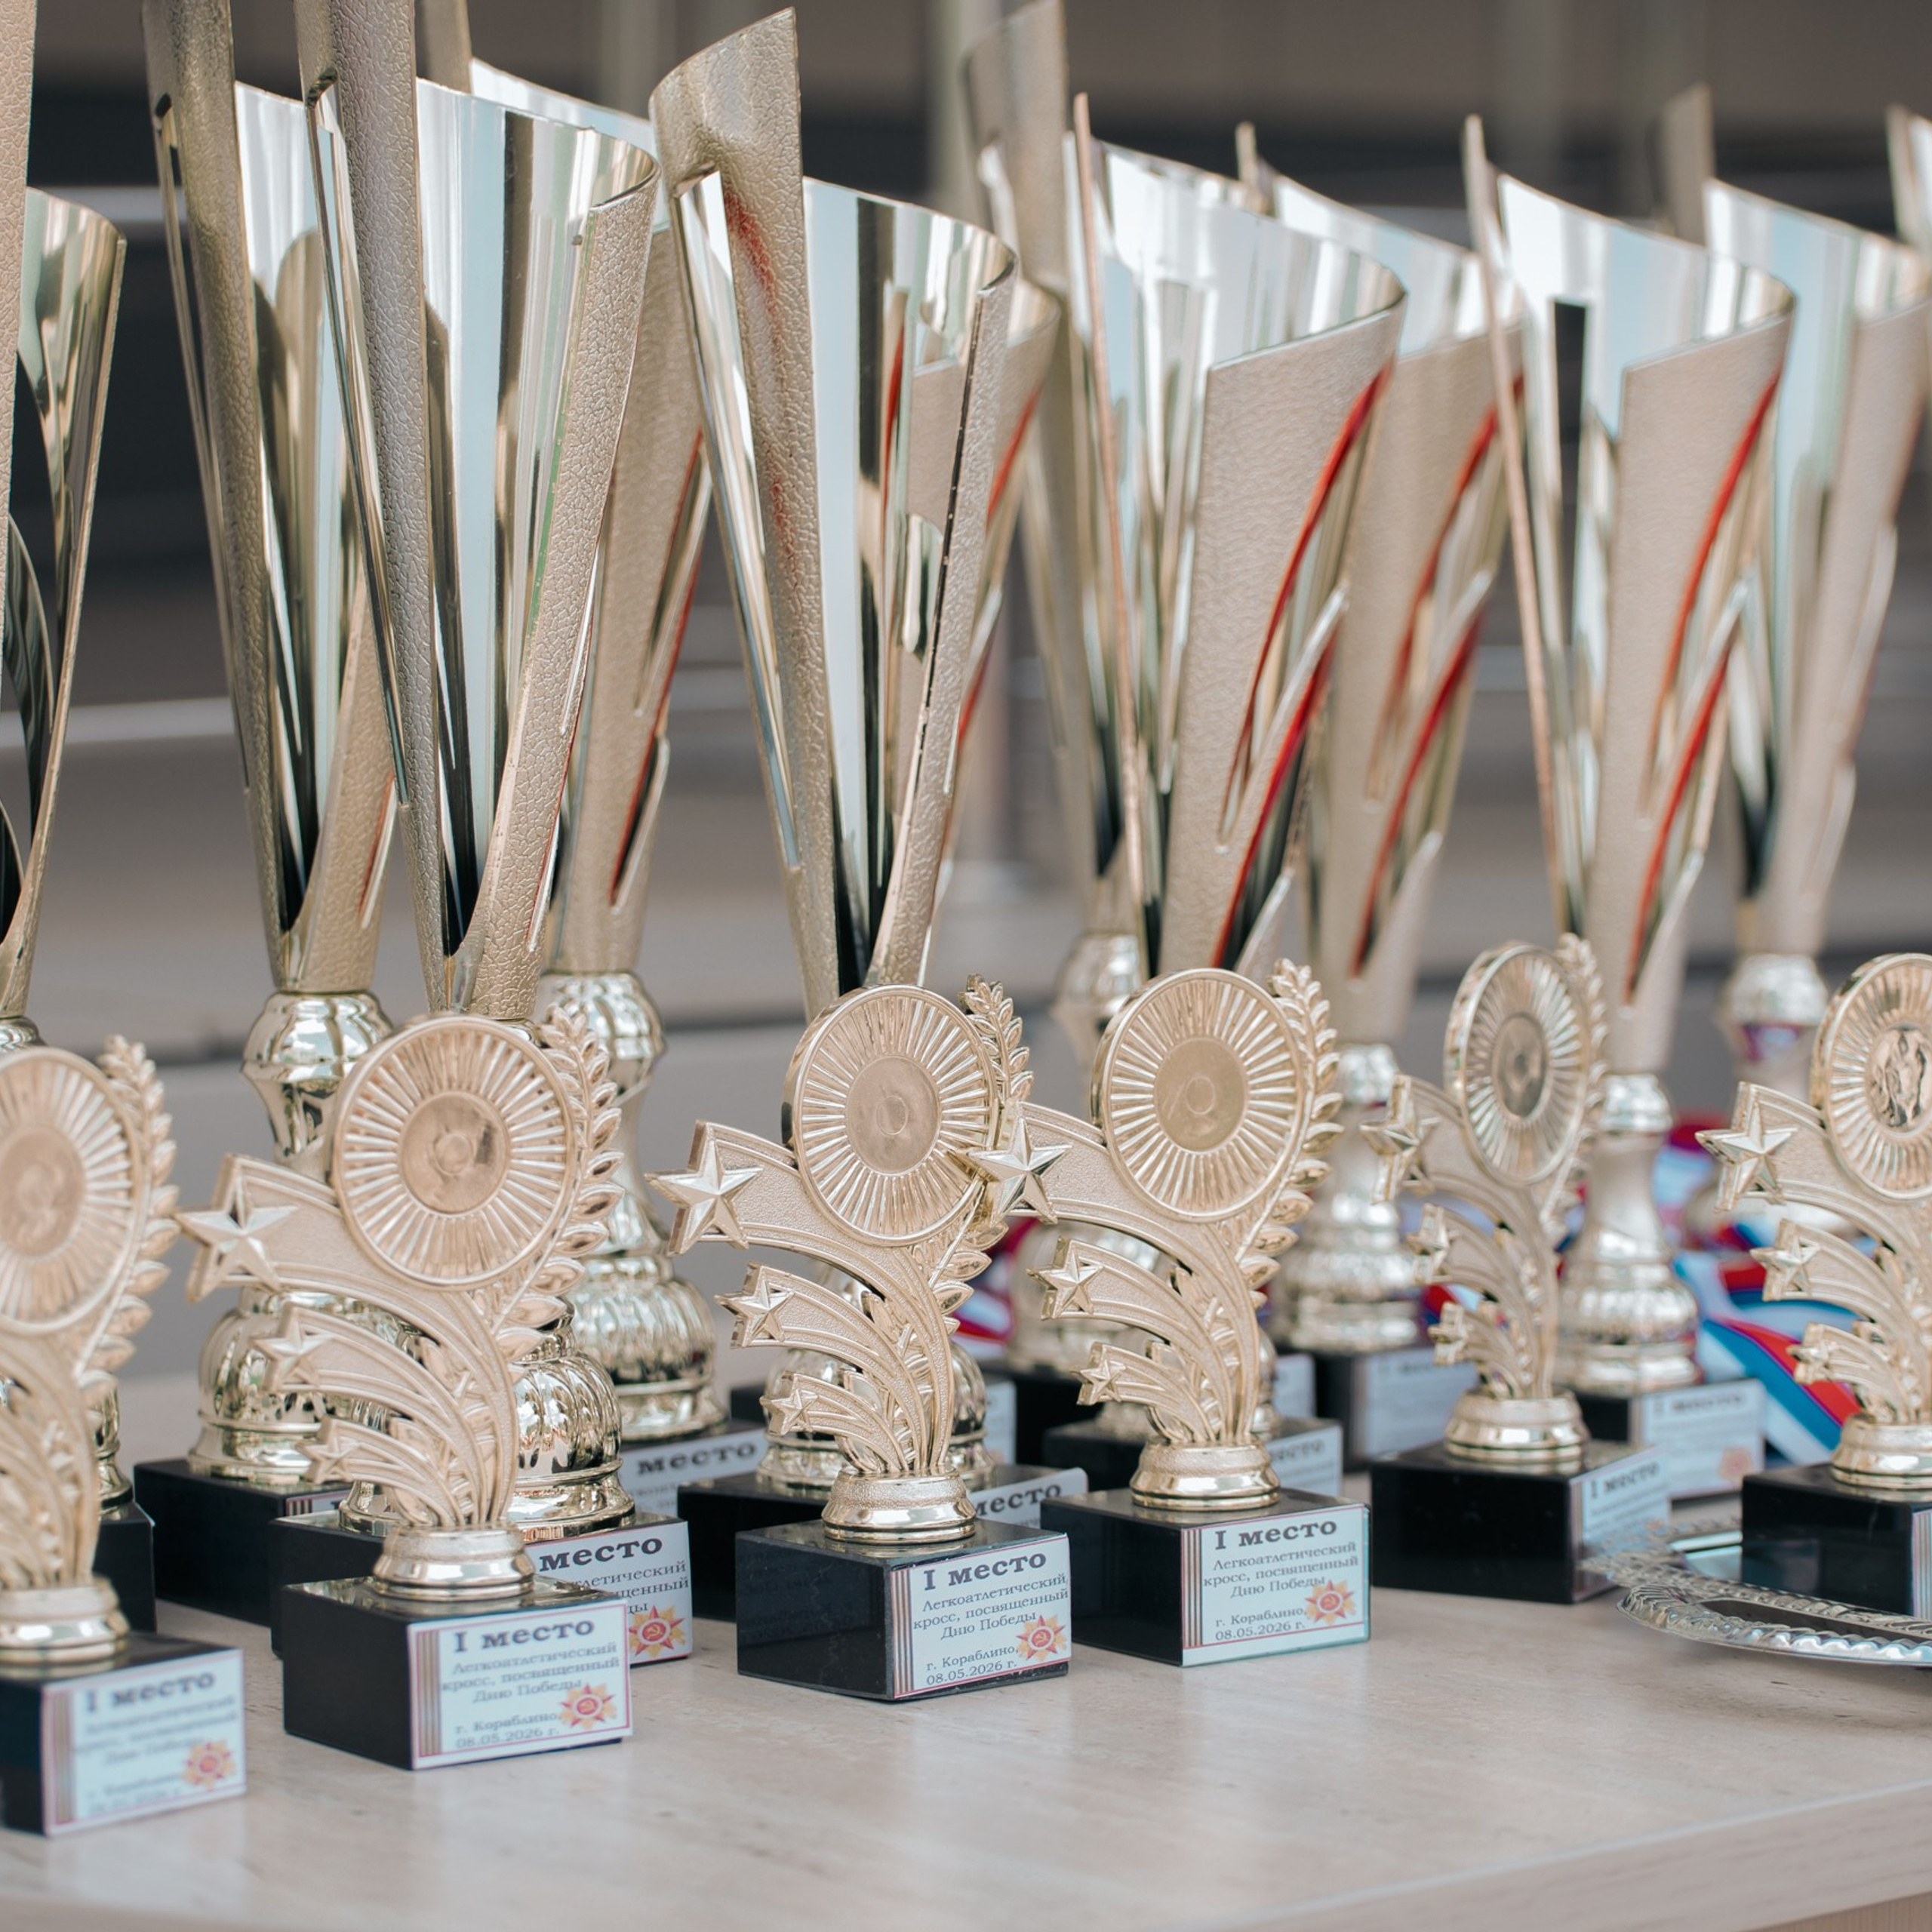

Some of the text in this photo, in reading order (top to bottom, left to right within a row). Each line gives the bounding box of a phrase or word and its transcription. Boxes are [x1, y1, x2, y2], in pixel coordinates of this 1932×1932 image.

[638, 1443, 755, 1474] место
[1238, 1521, 1337, 1547] место
[539, 1538, 663, 1572] место
[948, 1553, 1046, 1586] место
[1213, 1542, 1356, 1571] Легкоатлетический
[575, 1560, 686, 1588] летический
[1204, 1555, 1358, 1587] кросс, посвященный
[616, 1577, 689, 1598] щенный
[922, 1573, 1066, 1612] Легкоатлетический
[1230, 1577, 1325, 1598] Дню Победы
[913, 1588, 1069, 1630] кросс, посвященный
[1216, 1619, 1226, 1627] г.
[481, 1620, 594, 1649] место
[940, 1612, 1036, 1641] Дню Победы
[1216, 1620, 1306, 1641] 08.05.2026 г.
[926, 1645, 1019, 1671] г. Кораблино,
[927, 1660, 1017, 1685] 08.05.2026 г.
[112, 1672, 214, 1706] место
[456, 1727, 543, 1749] 08.05.2026
